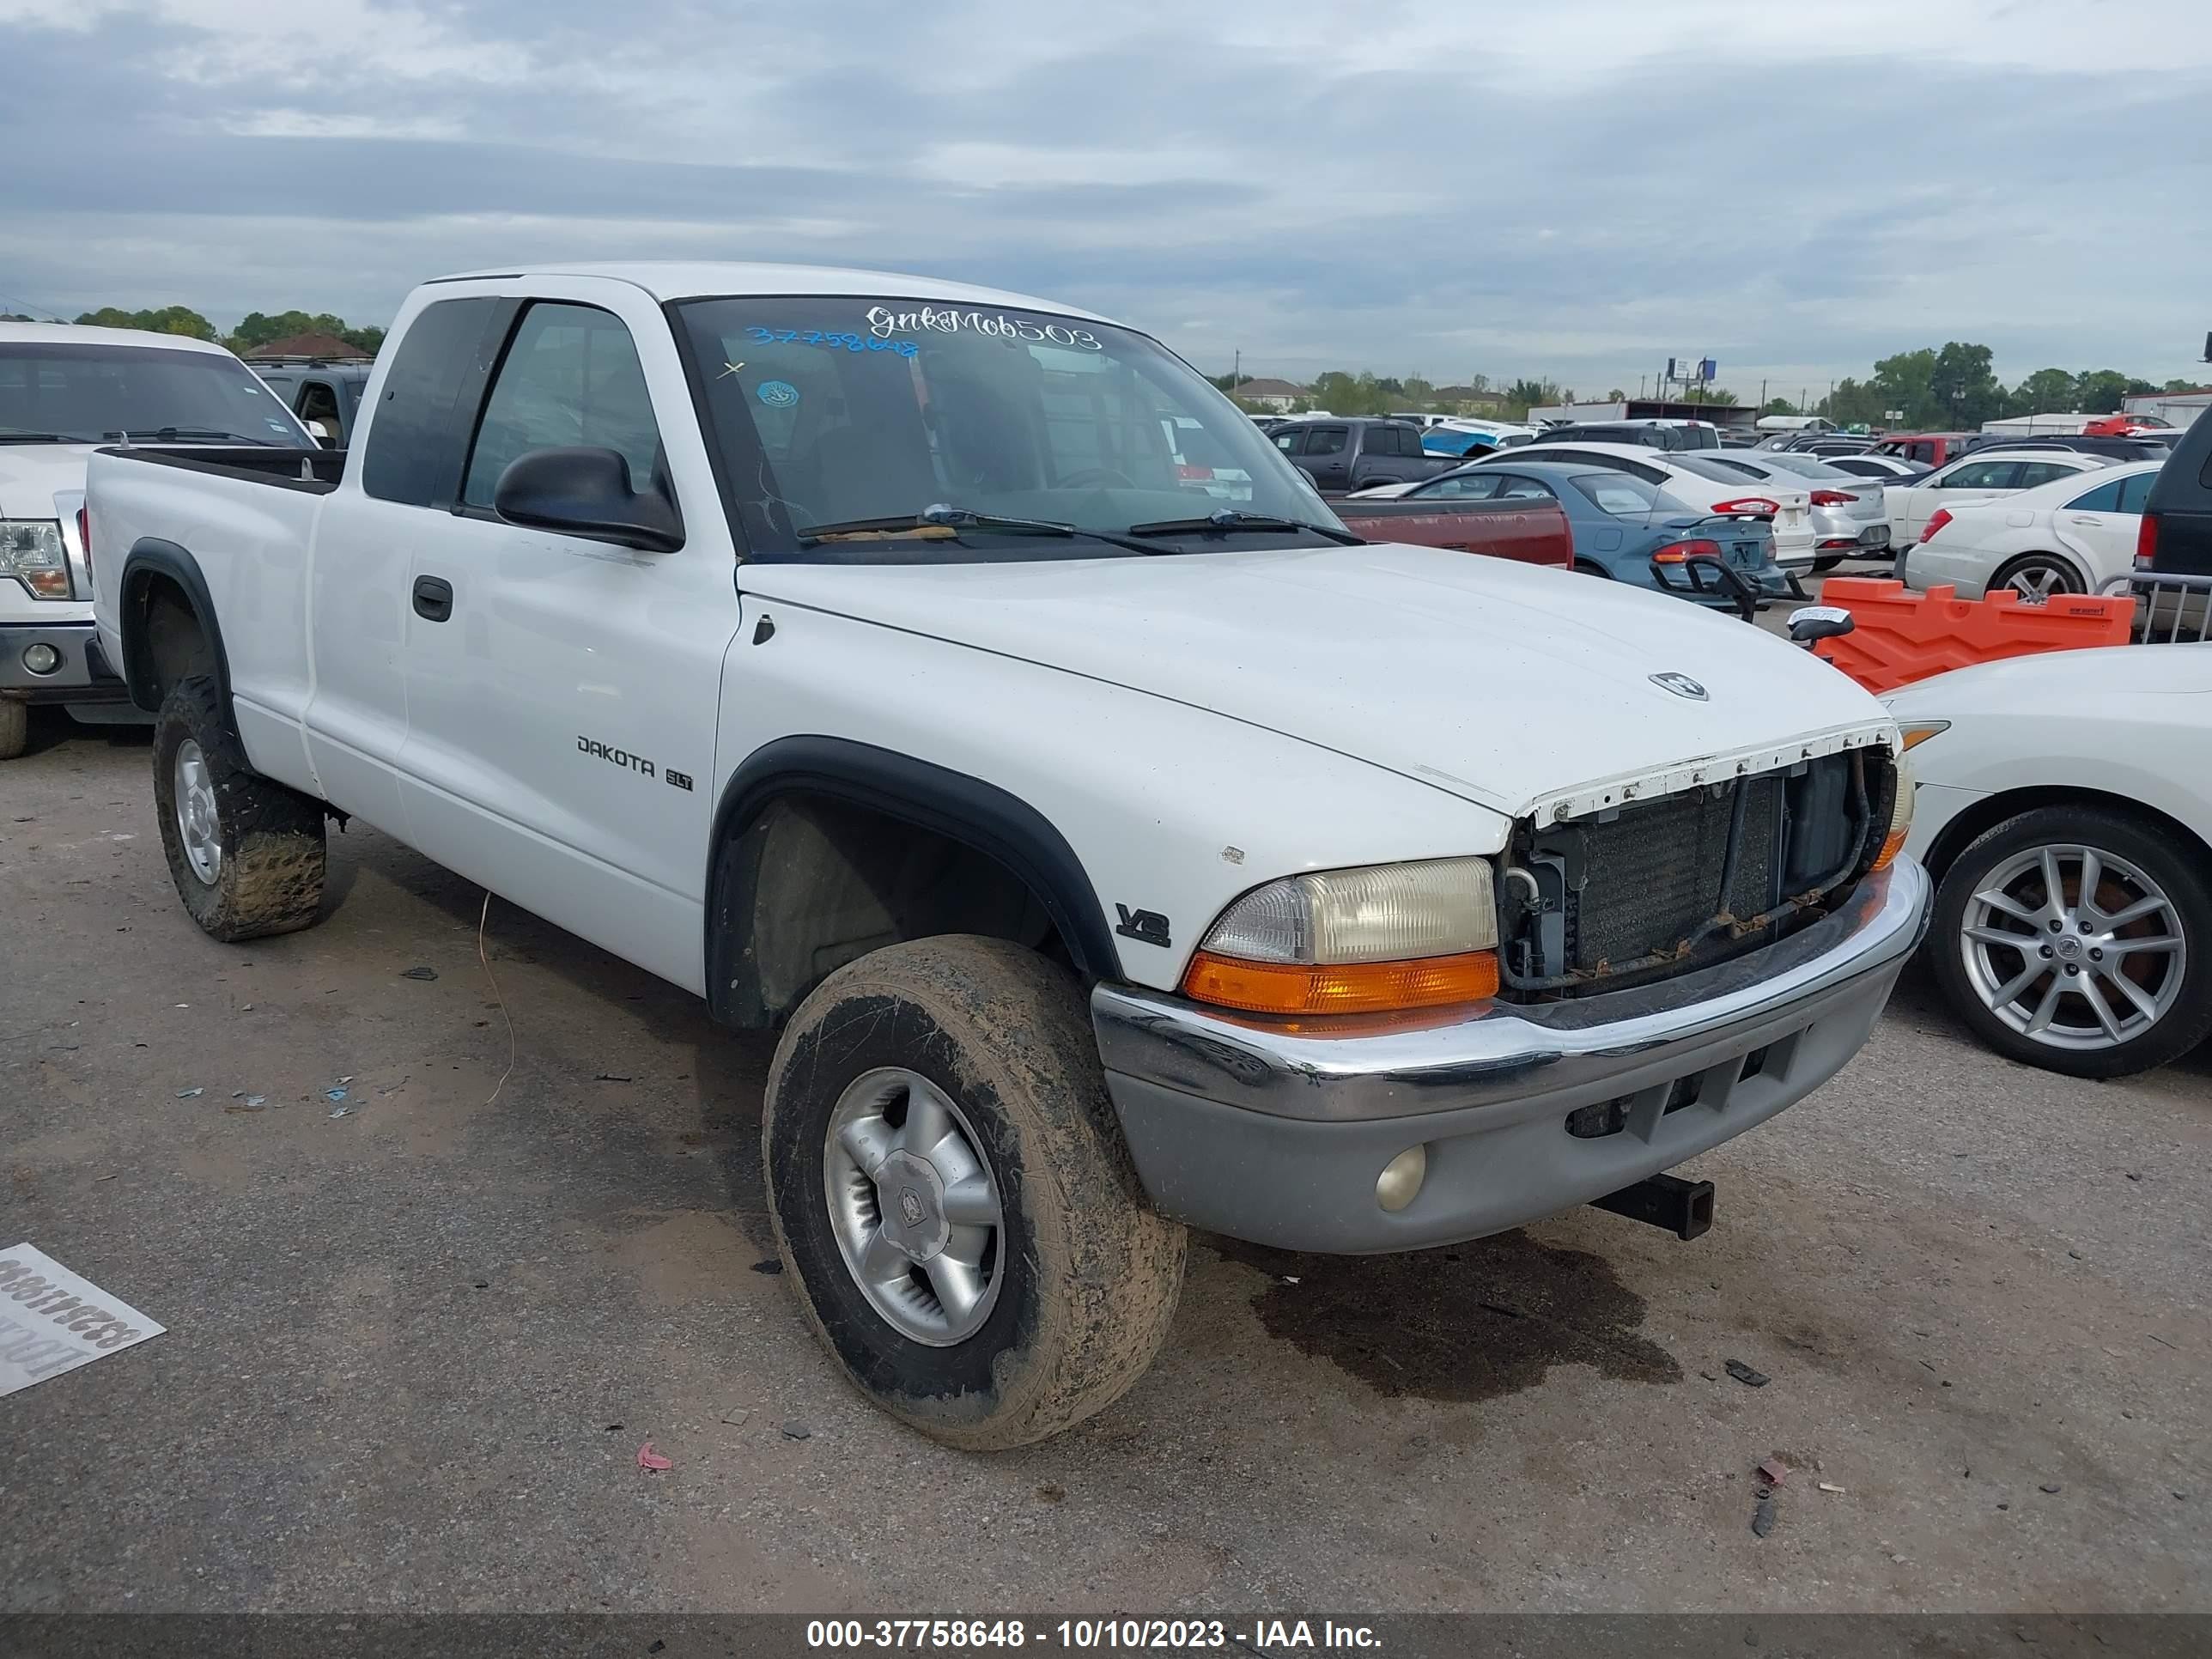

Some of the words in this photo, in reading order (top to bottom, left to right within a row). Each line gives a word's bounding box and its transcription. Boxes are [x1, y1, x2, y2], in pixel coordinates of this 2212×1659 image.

[745, 327, 920, 358] 37758648
[577, 735, 655, 778] DAKOTA
[665, 769, 694, 791] SLT
[1115, 902, 1170, 944] V8
